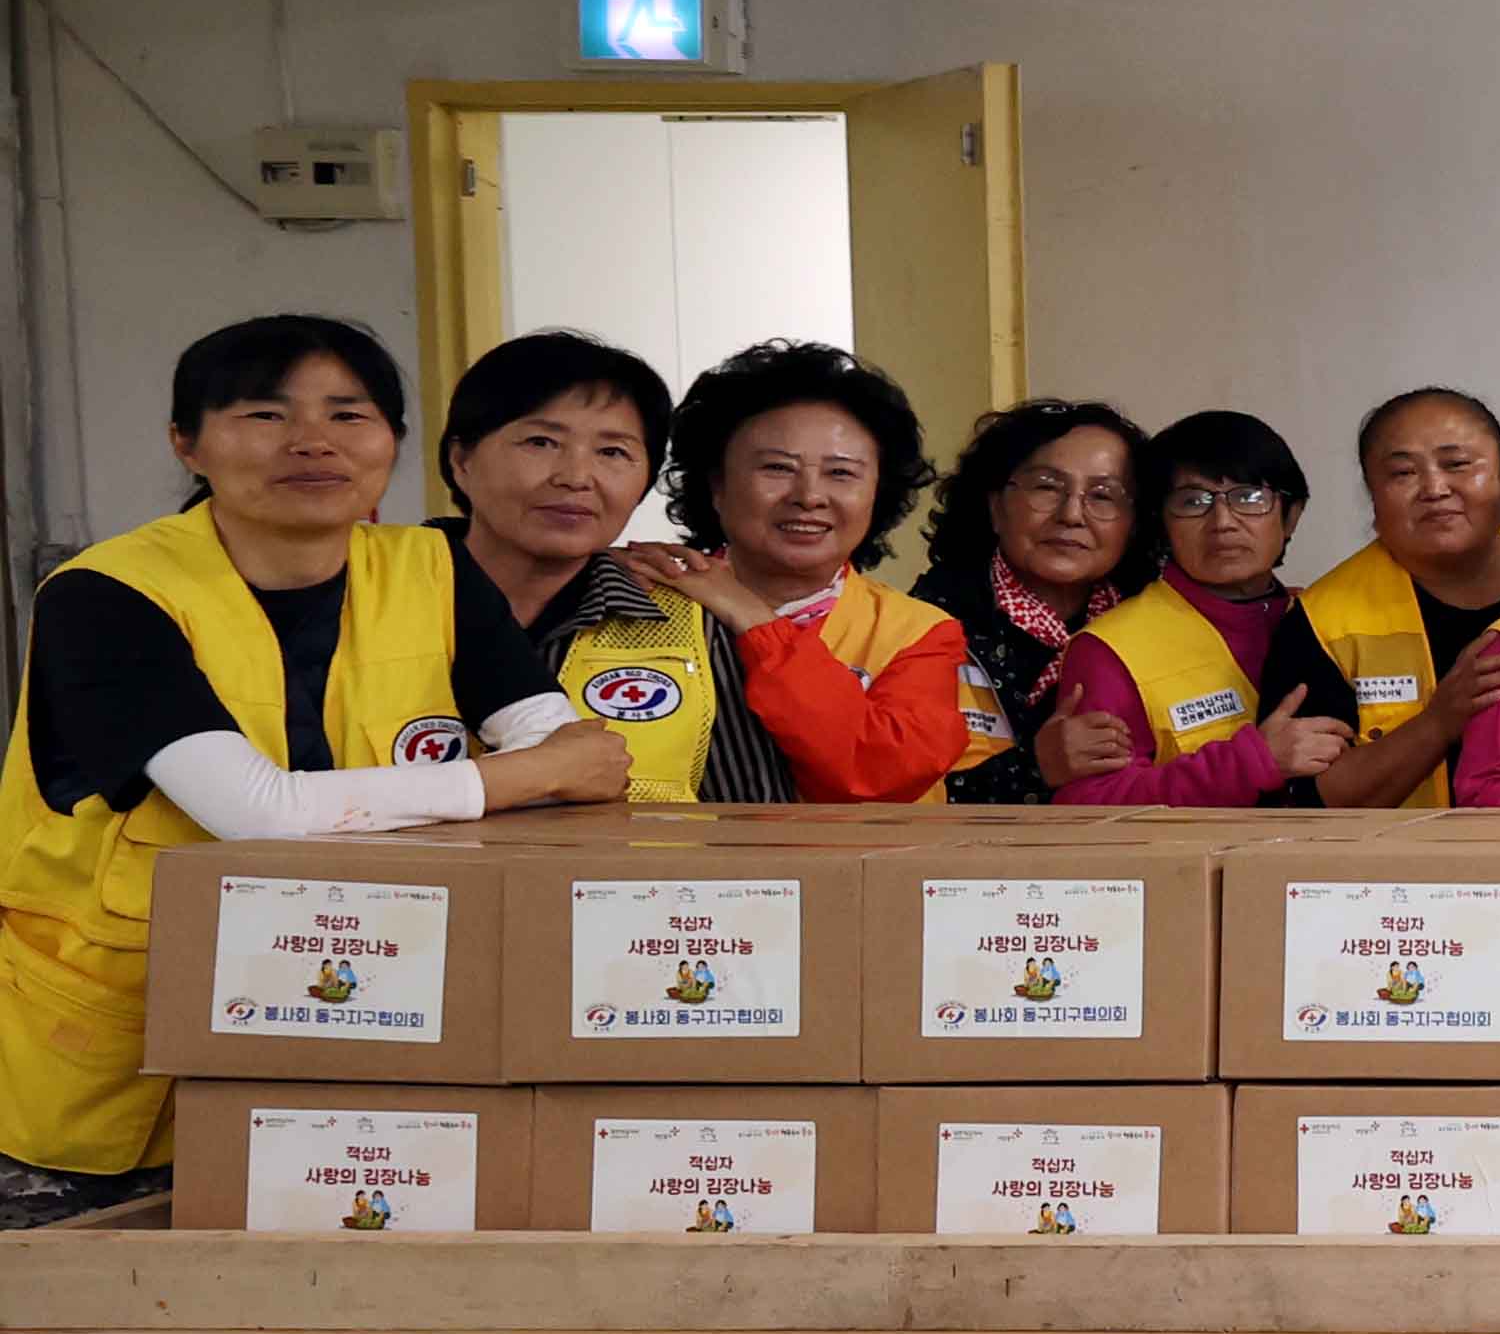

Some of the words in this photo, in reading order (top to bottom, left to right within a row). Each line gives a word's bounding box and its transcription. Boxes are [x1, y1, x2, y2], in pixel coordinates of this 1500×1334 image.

[313, 914, 361, 933] 적십자
[271, 933, 325, 954] 사랑의
[329, 936, 400, 958] 김장나눔
[1389, 1150, 1434, 1166] 적십자
[1352, 1173, 1401, 1190] 사랑의
[1407, 1173, 1474, 1190] 김장나눔
